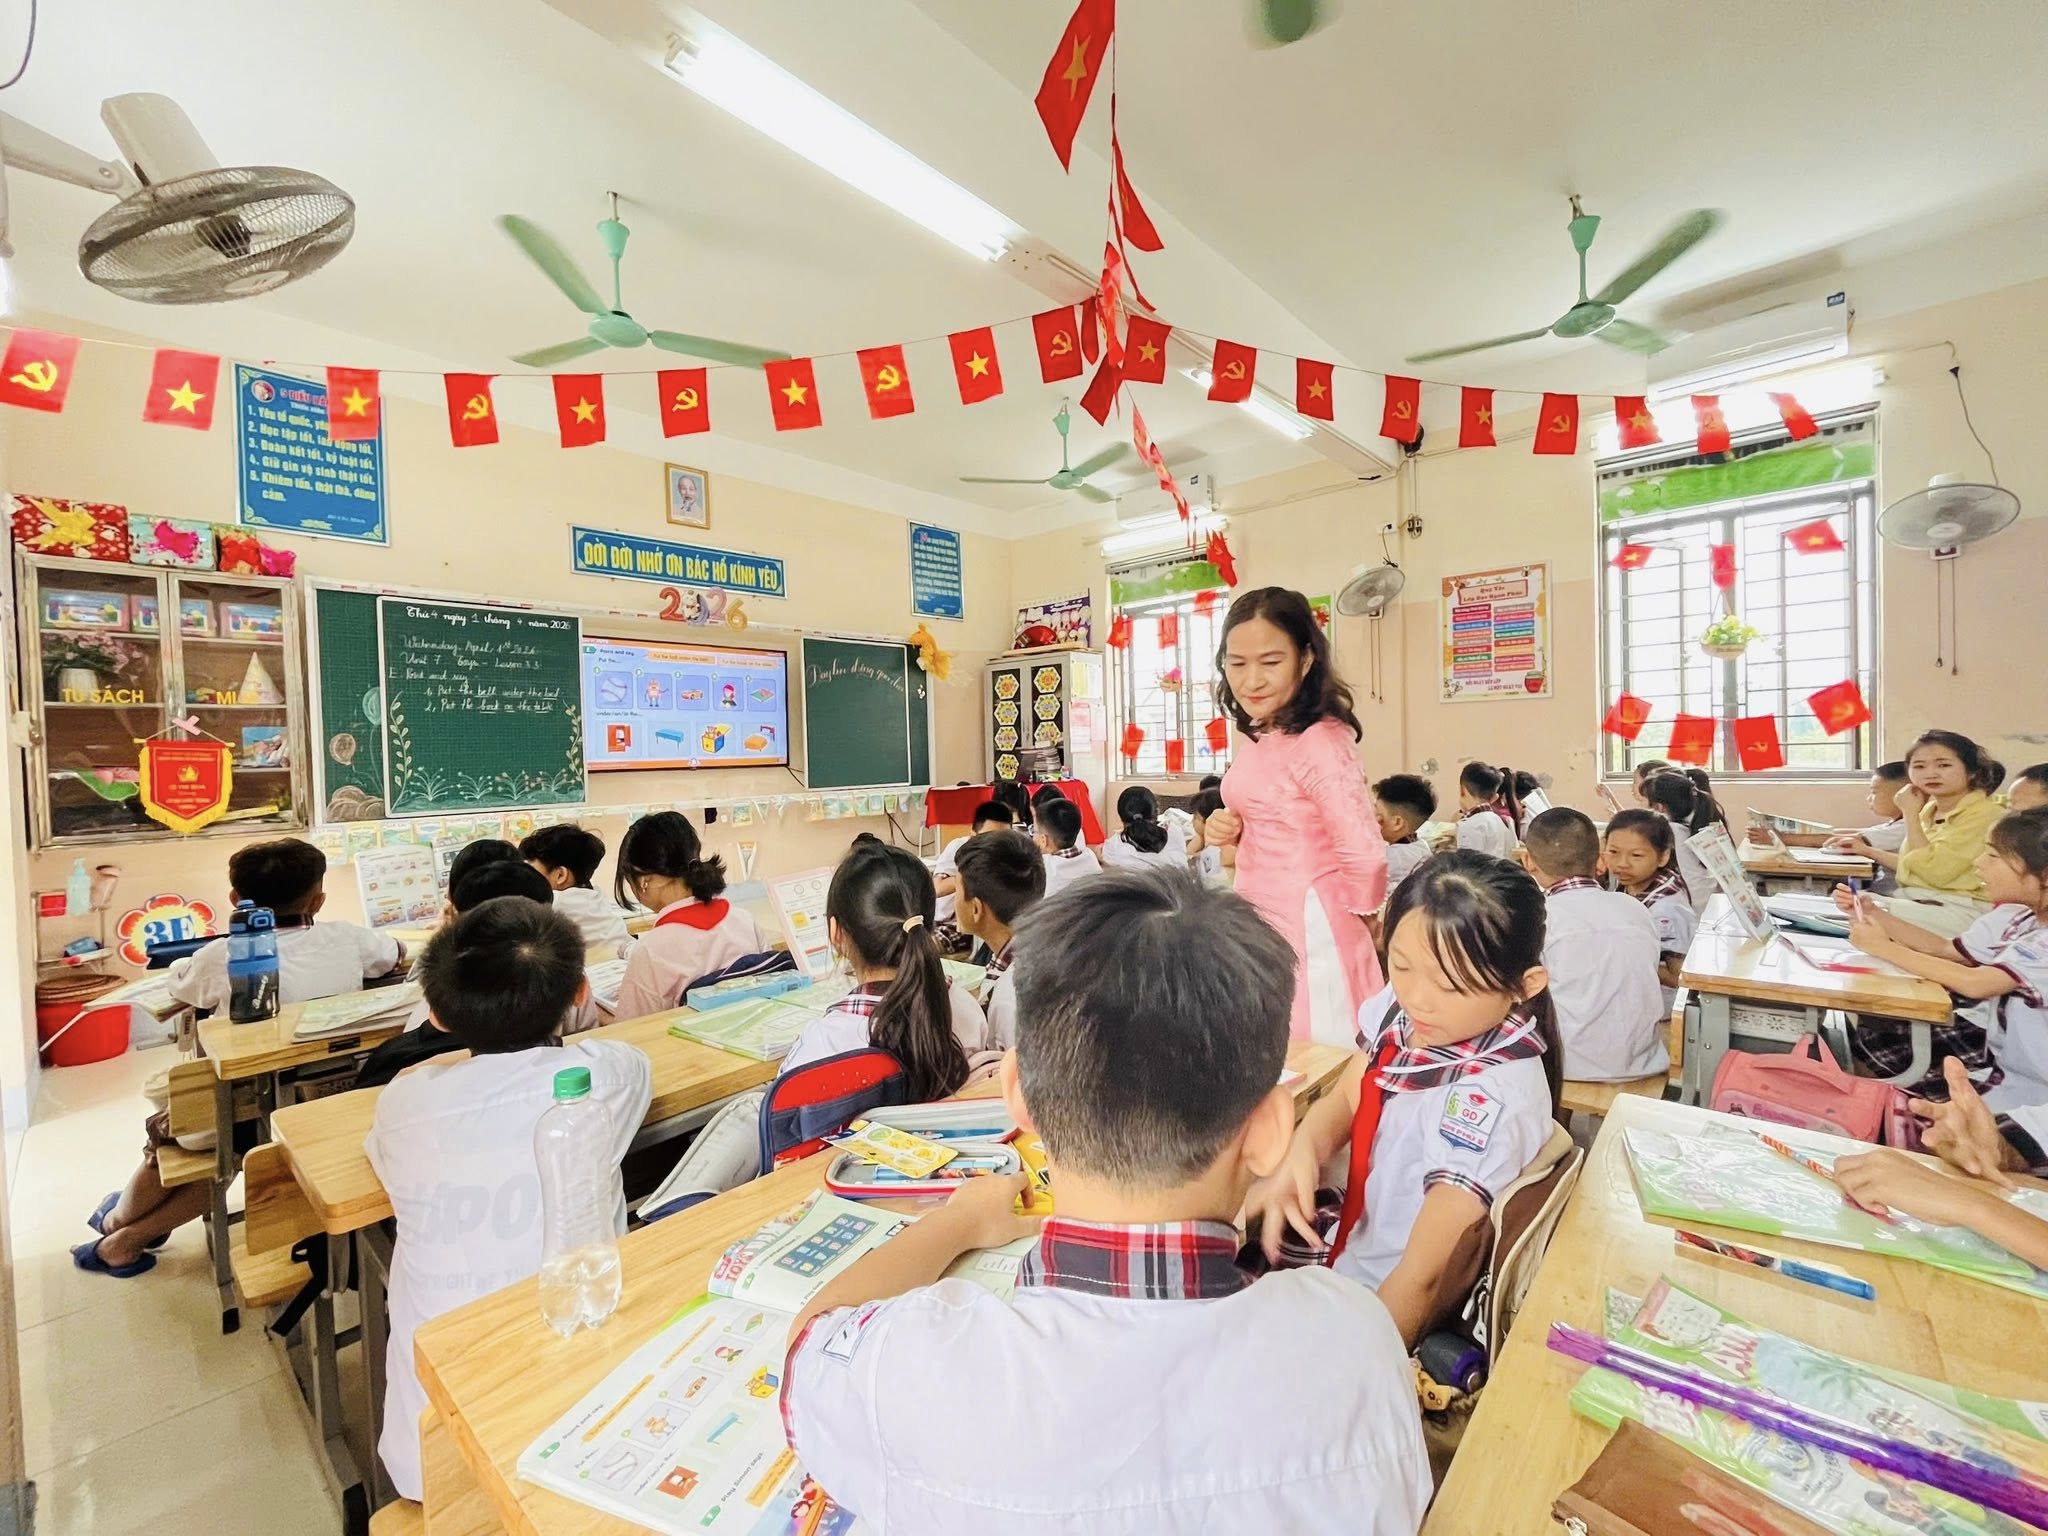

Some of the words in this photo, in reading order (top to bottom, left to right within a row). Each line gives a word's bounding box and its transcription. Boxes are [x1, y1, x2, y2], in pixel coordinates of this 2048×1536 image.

[248, 405, 256, 416] 1.
[258, 407, 276, 420] Yêu
[248, 421, 257, 432] 2.
[260, 423, 279, 437] Học
[249, 438, 258, 449] 3.
[249, 454, 260, 465] 4.
[316, 467, 336, 478] sinh
[249, 470, 260, 482] 5.
[583, 537, 608, 567] ĐỜI
[610, 542, 634, 571] ĐỜI
[636, 546, 663, 575] NHỚ
[665, 553, 683, 577] ƠN
[686, 554, 709, 581] BÁC
[730, 560, 756, 587] KÍNH
[757, 564, 778, 591] YÊU
[431, 608, 438, 619] 4
[443, 613, 466, 628] ngày
[472, 612, 480, 623] 1
[484, 613, 511, 630] tháng
[528, 619, 549, 628] năm
[434, 654, 441, 665] 7
[91, 685, 144, 704] SÁCH
[143, 914, 197, 947] 3E
[1462, 1108, 1478, 1121] GD
[733, 1466, 752, 1488] Simon
